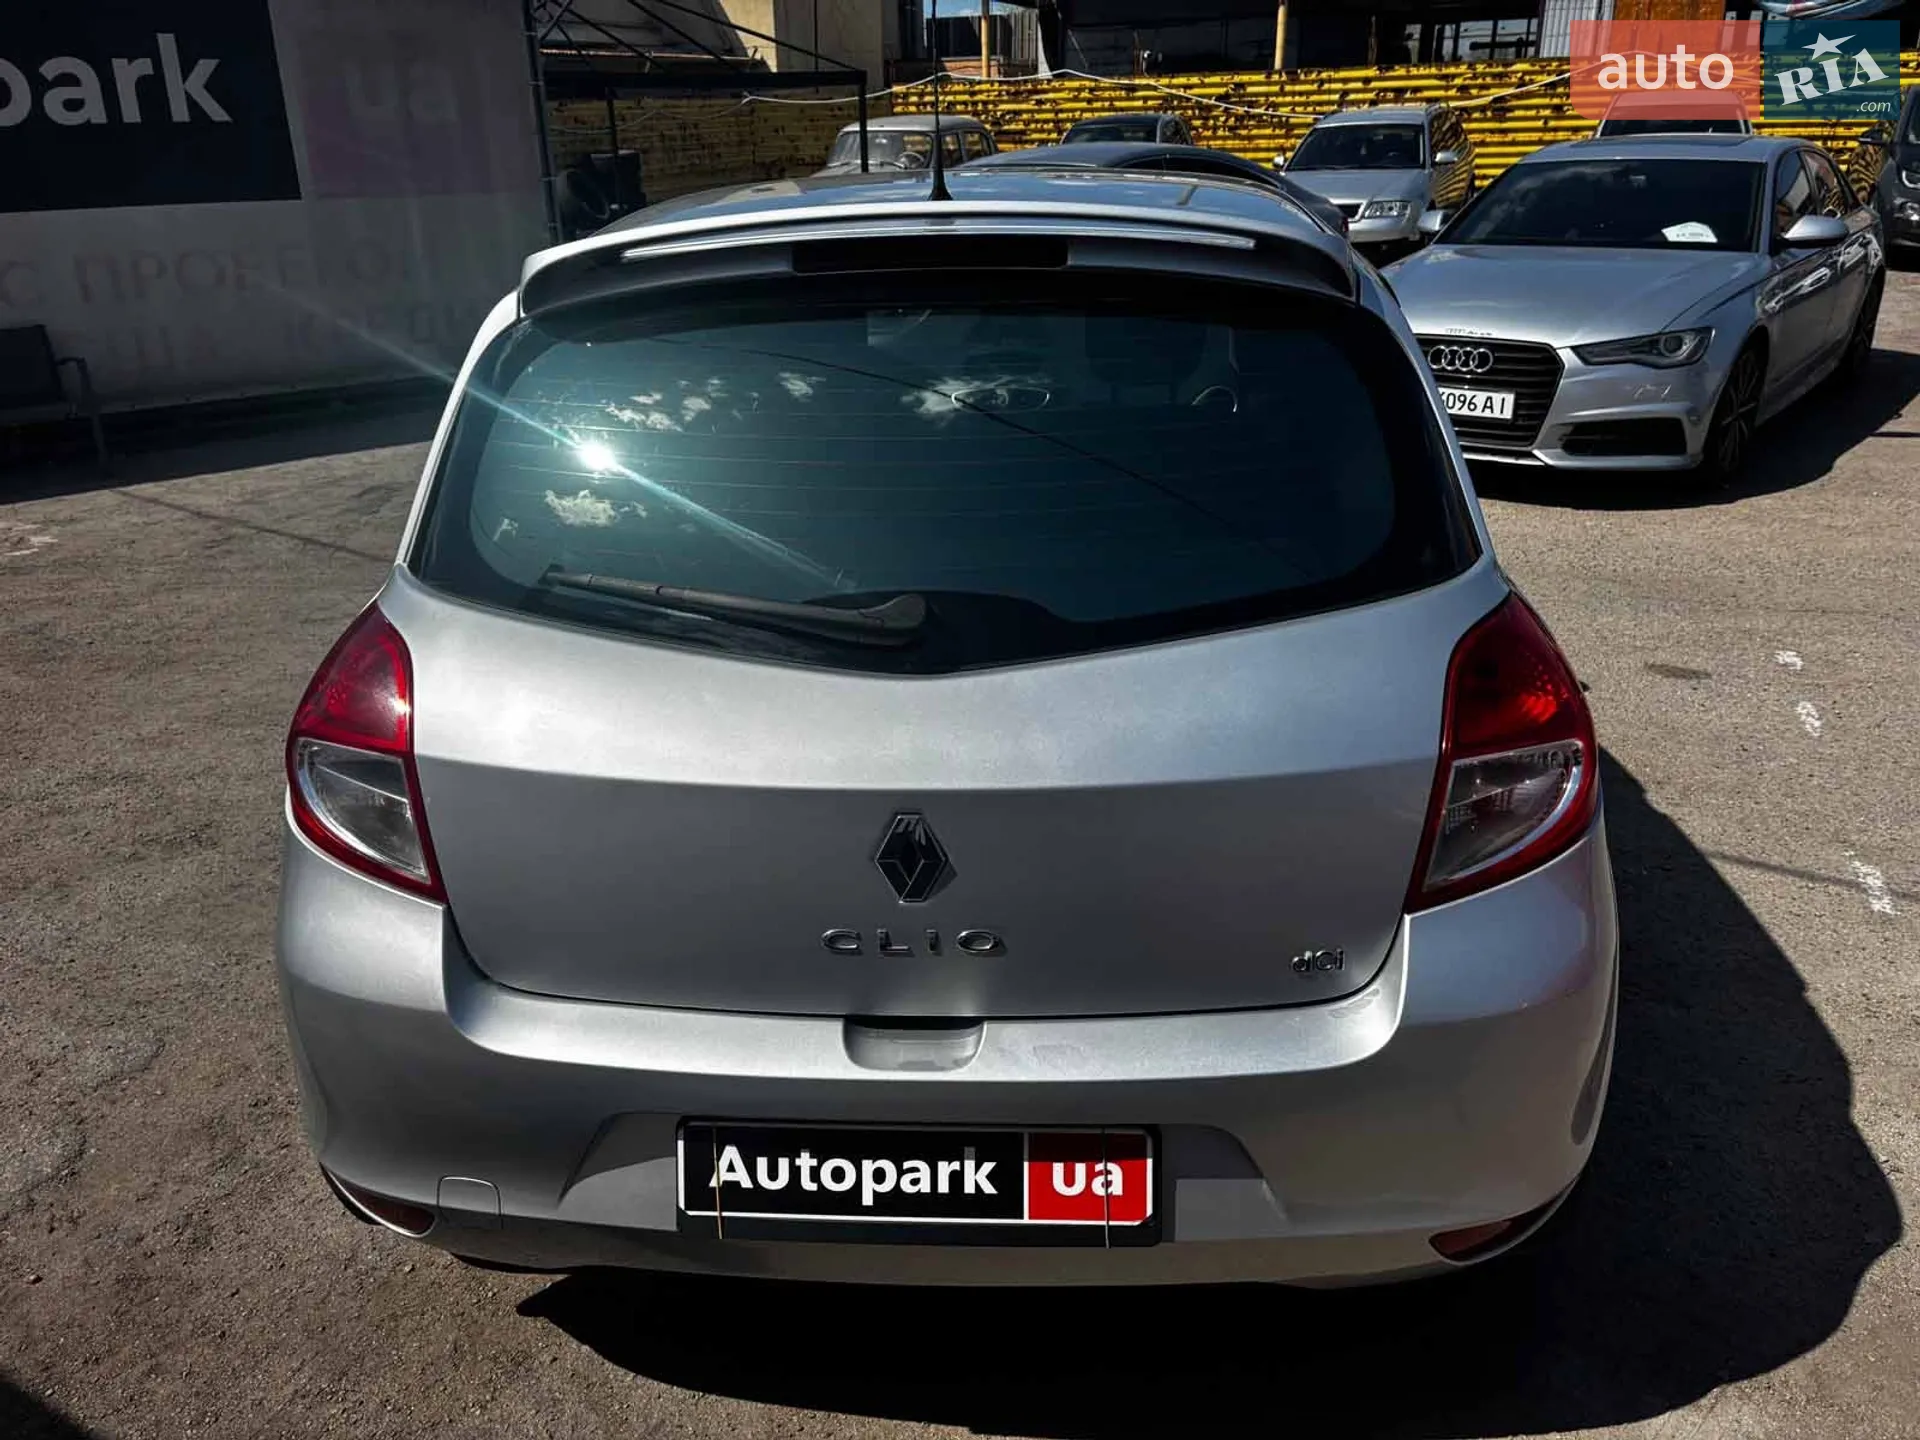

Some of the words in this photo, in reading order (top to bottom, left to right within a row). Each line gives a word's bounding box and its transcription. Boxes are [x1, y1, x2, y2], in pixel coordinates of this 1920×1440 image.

[822, 928, 1005, 955] CLIO
[1291, 949, 1345, 973] dCi
[709, 1144, 998, 1206] Autopark
[1052, 1161, 1124, 1197] ua
